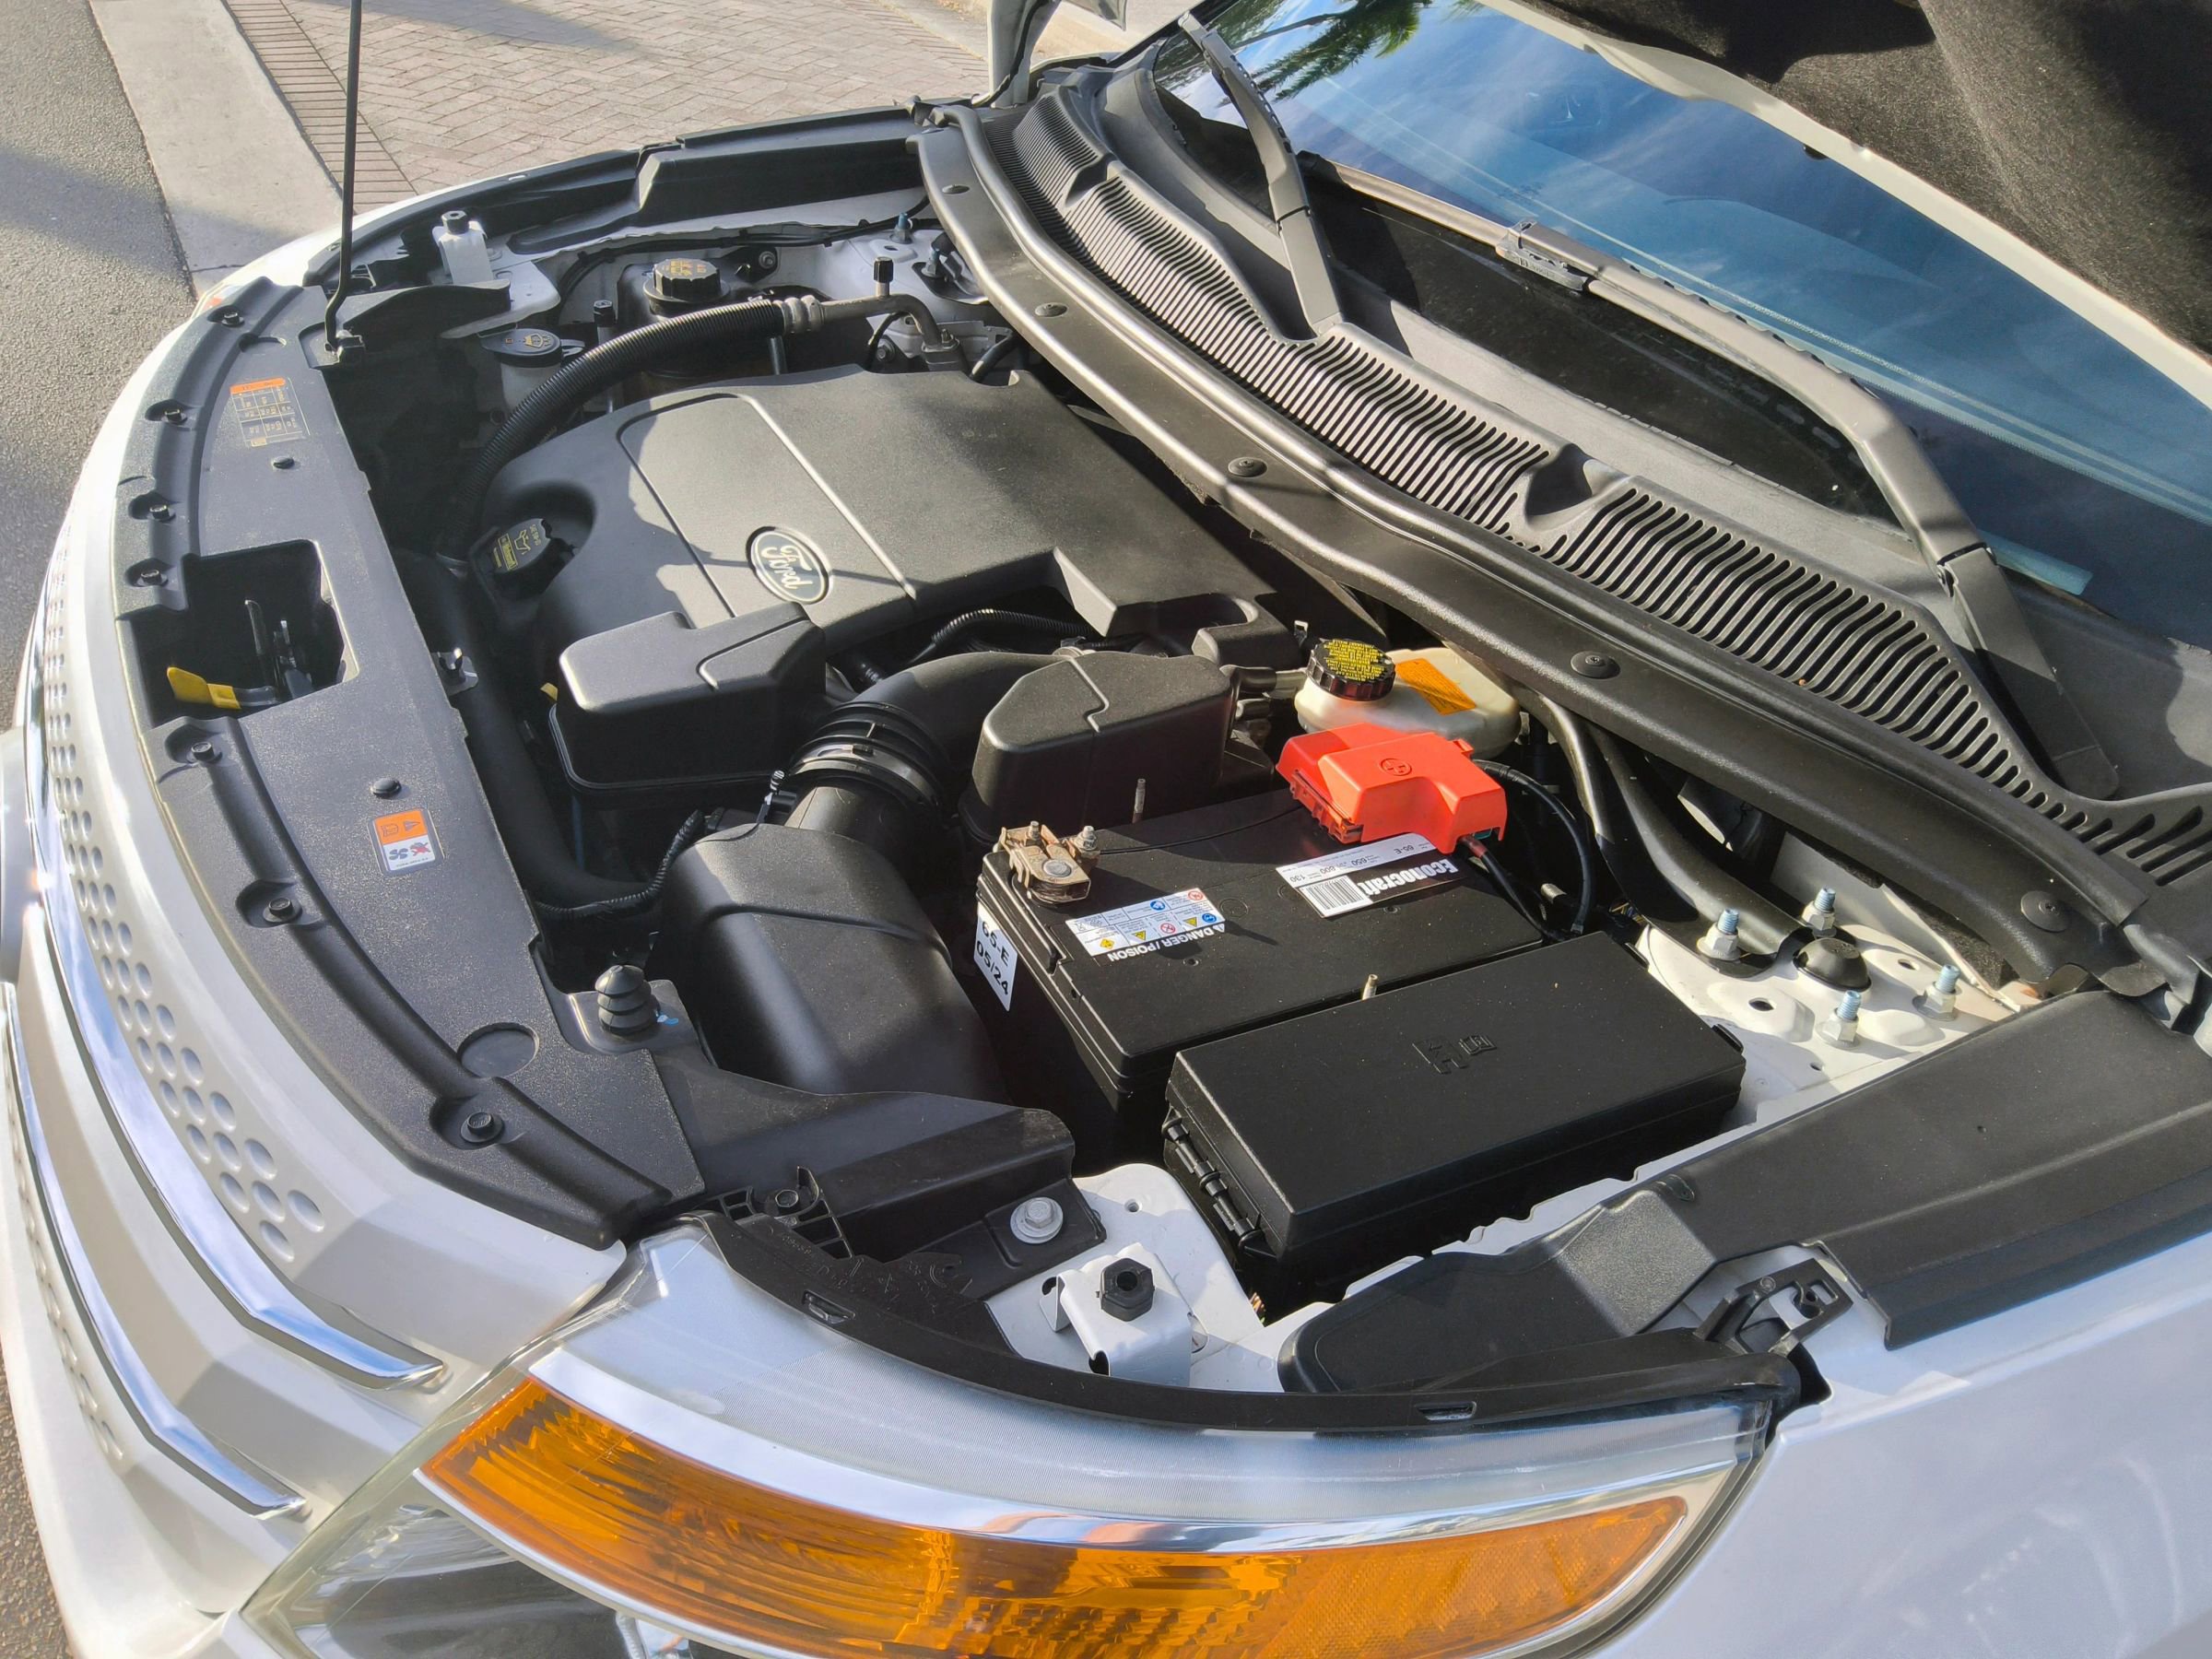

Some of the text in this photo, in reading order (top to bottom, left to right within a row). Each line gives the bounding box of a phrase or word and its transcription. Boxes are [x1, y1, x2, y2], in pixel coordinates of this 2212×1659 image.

[760, 545, 813, 590] Ford
[1358, 858, 1458, 896] Econocraft
[982, 921, 1009, 967] 65-E
[1107, 944, 1157, 962] POISON
[1162, 928, 1215, 947] DANGER
[976, 940, 1008, 995] 05/24
